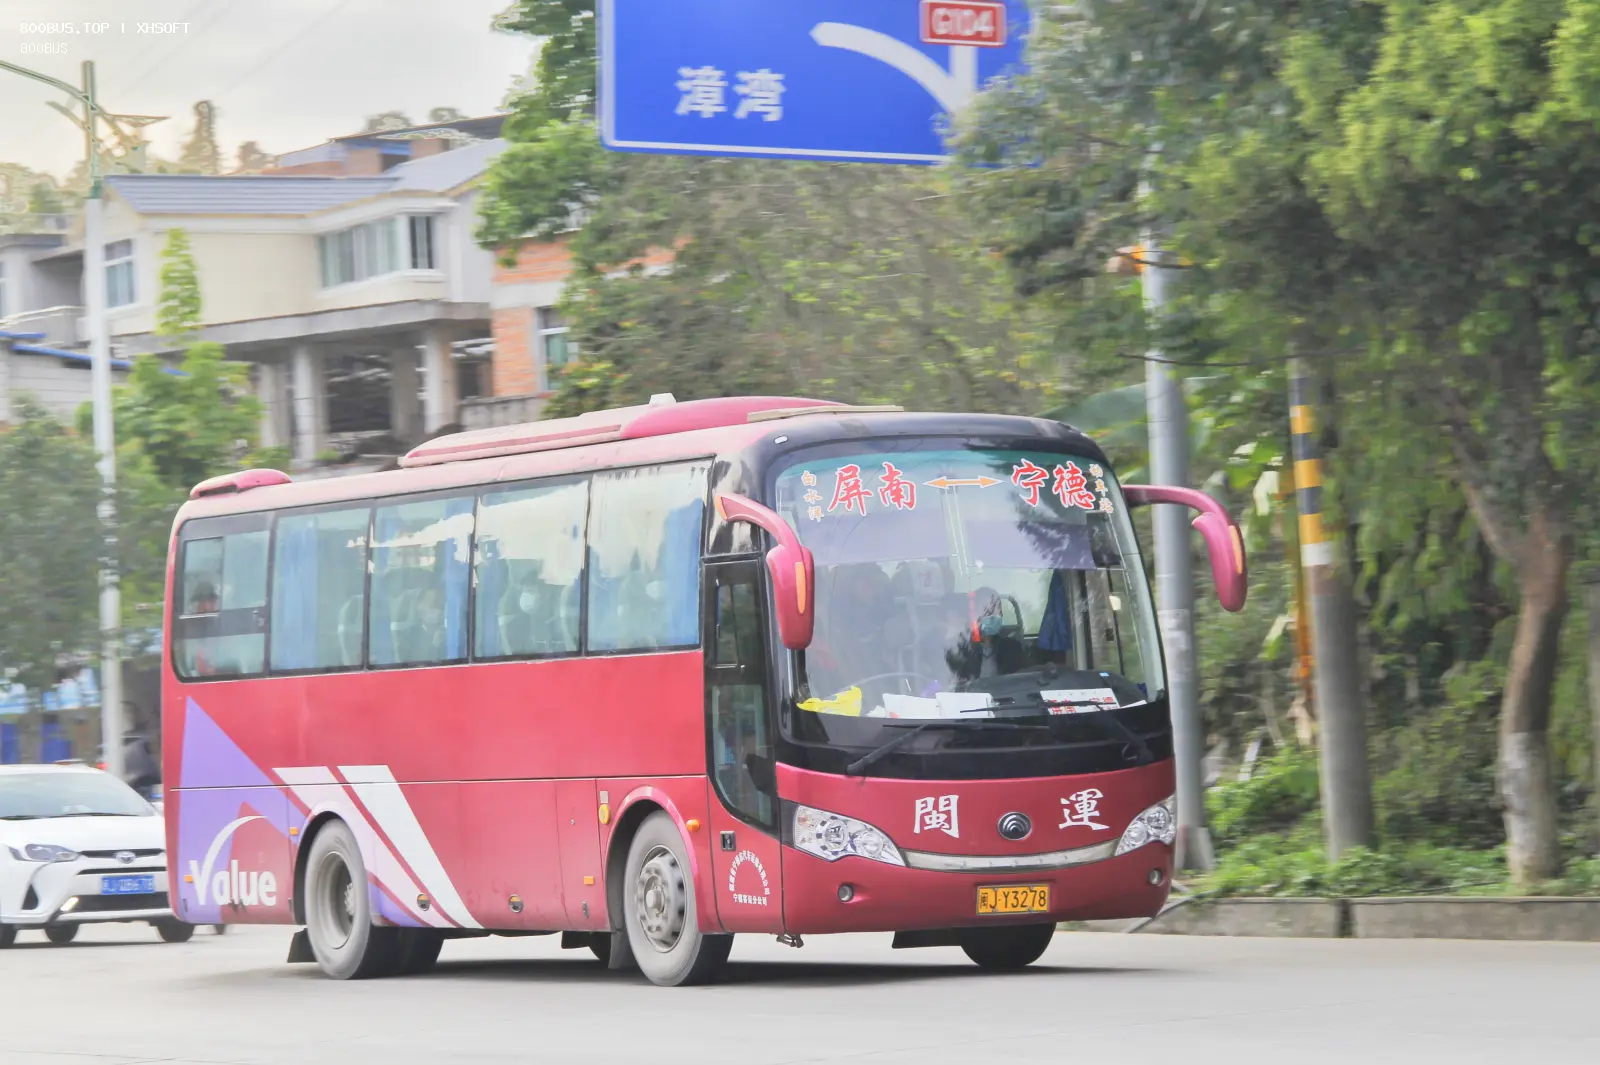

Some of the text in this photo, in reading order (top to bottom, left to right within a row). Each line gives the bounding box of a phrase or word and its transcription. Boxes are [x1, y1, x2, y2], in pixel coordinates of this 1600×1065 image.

[932, 7, 996, 38] G104
[674, 65, 786, 122] 漳湾
[827, 458, 1096, 516] 屏南 宁德
[187, 815, 277, 907] Value
